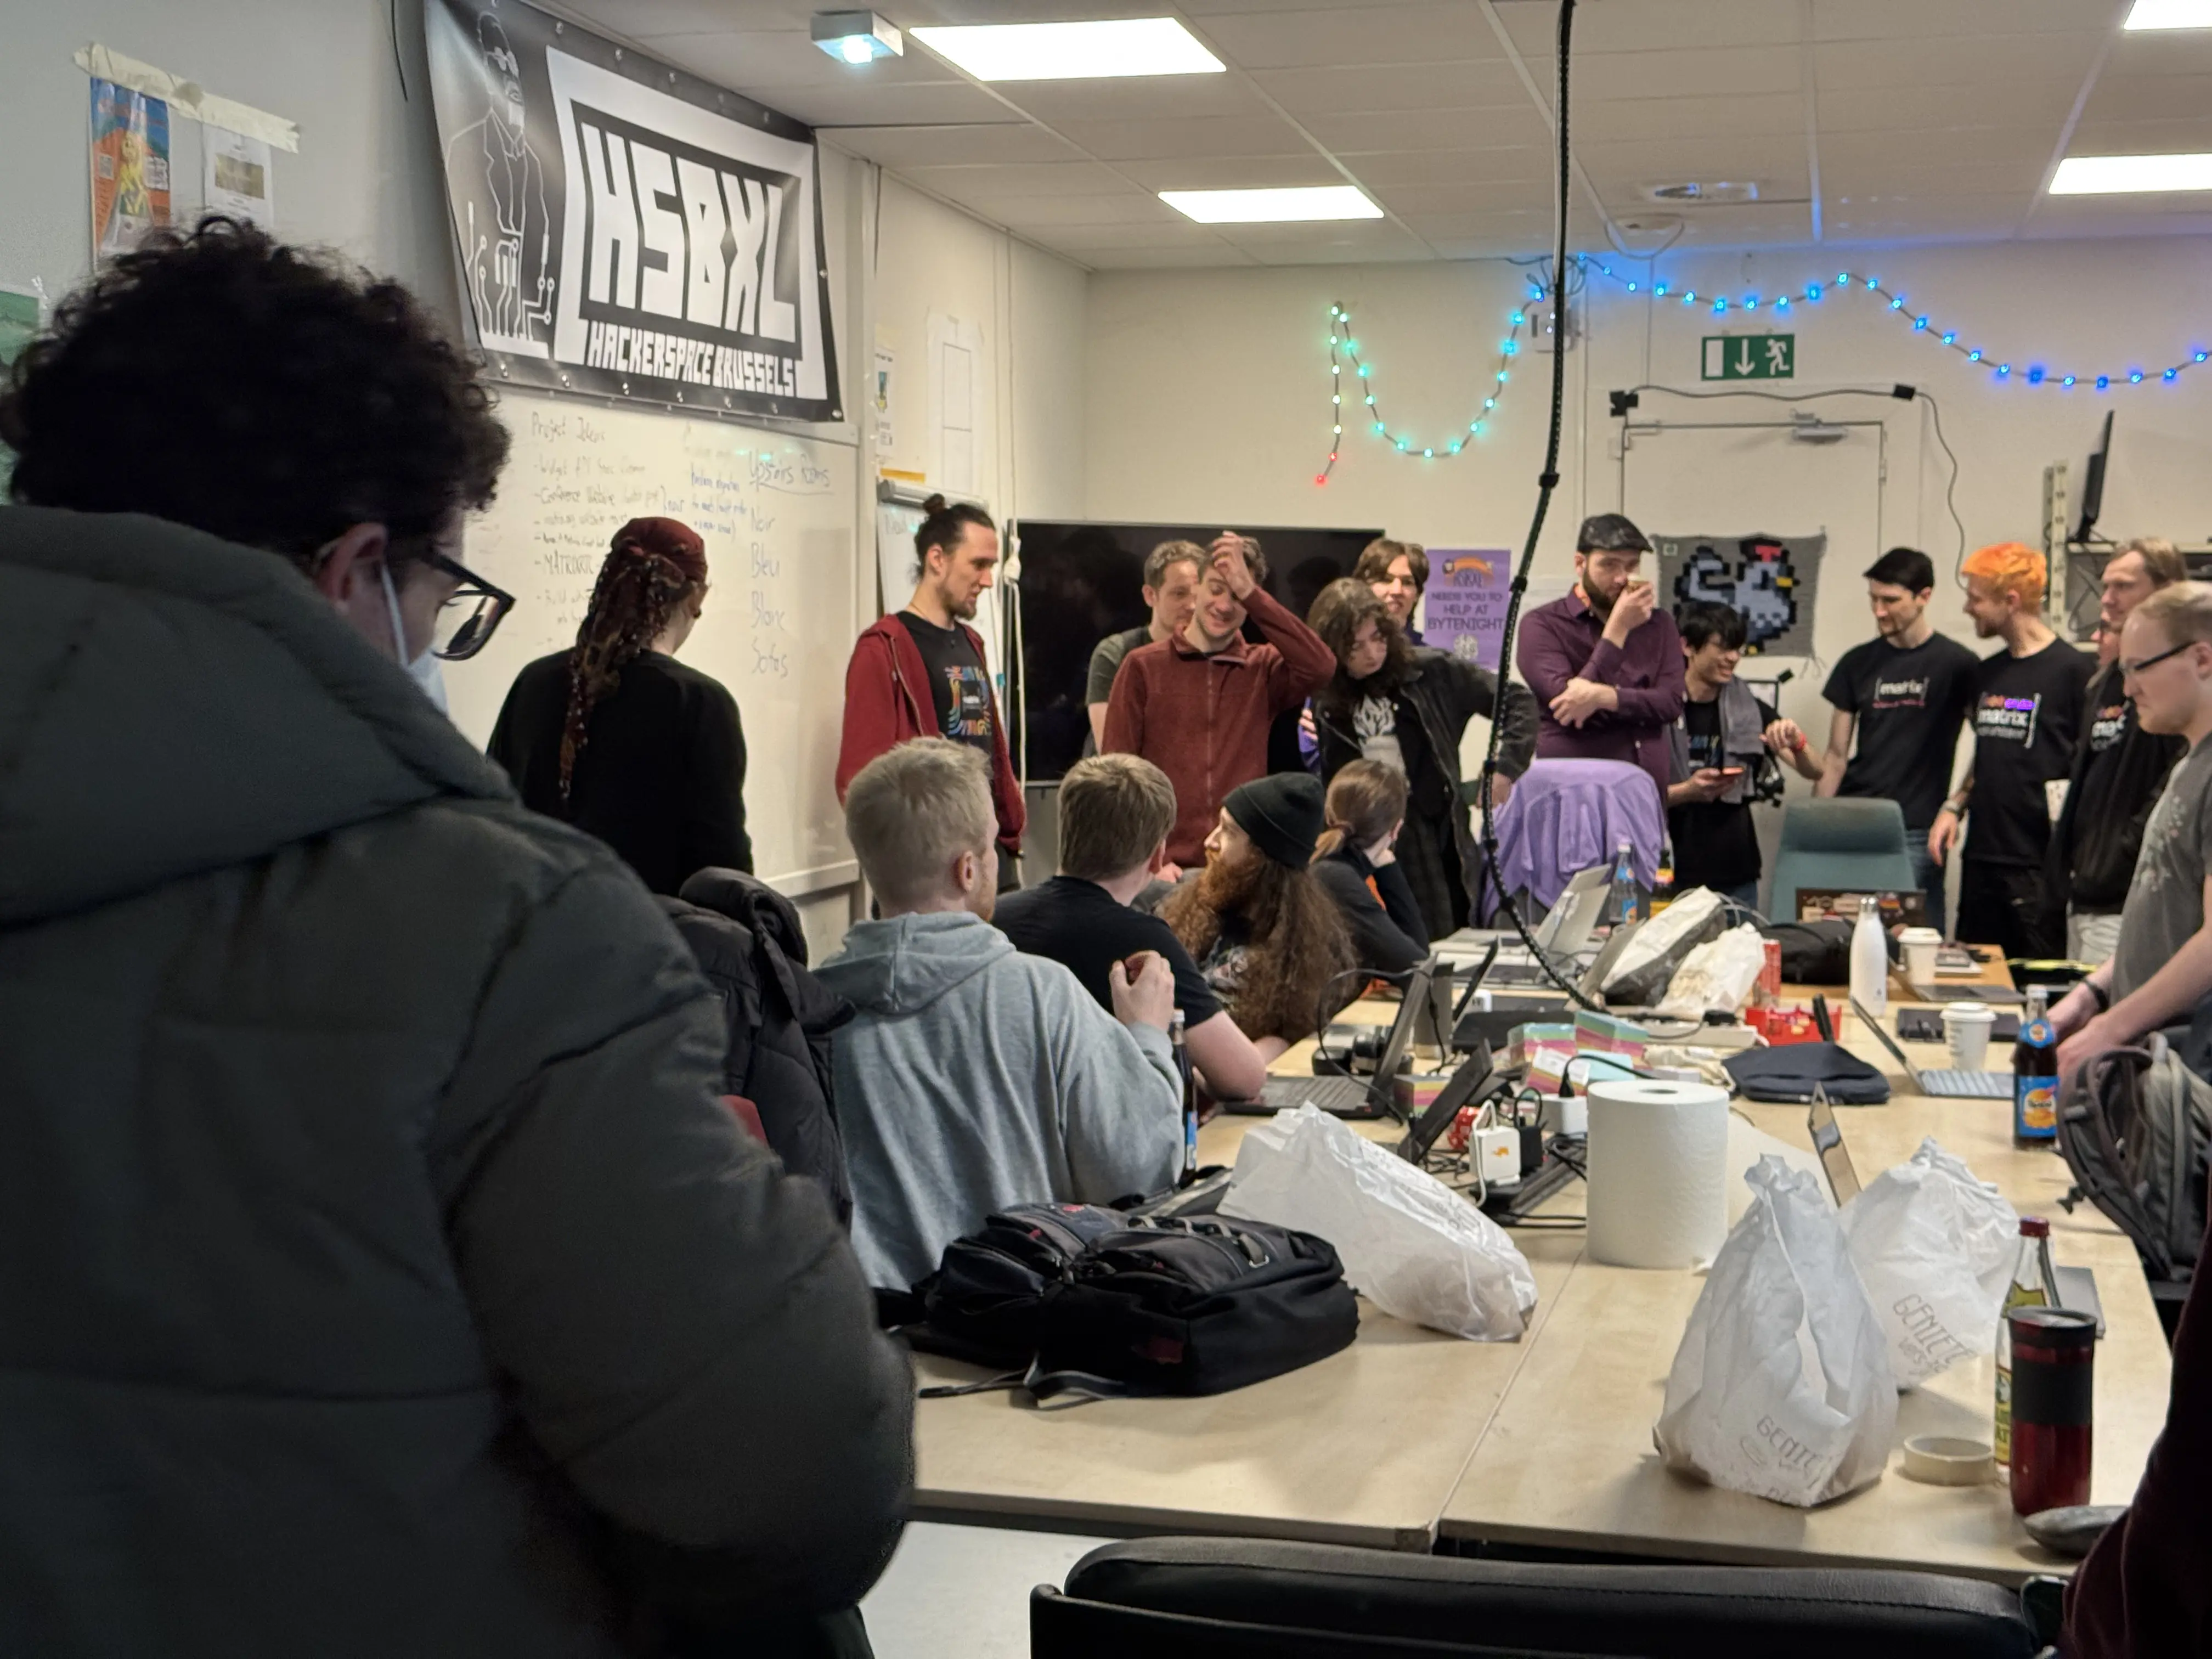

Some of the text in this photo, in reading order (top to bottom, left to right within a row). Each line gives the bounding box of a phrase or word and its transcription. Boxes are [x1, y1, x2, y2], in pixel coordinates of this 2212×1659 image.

[580, 122, 795, 343] HSBXL
[587, 320, 794, 398] HACKERSPACE BRUSSELS
[532, 411, 566, 443] Project
[751, 541, 780, 579] Bleu
[1443, 603, 1488, 616] HELP AT
[1465, 591, 1486, 602] YOU
[1489, 591, 1503, 602] TO
[1427, 617, 1504, 630] BYTENIGHT
